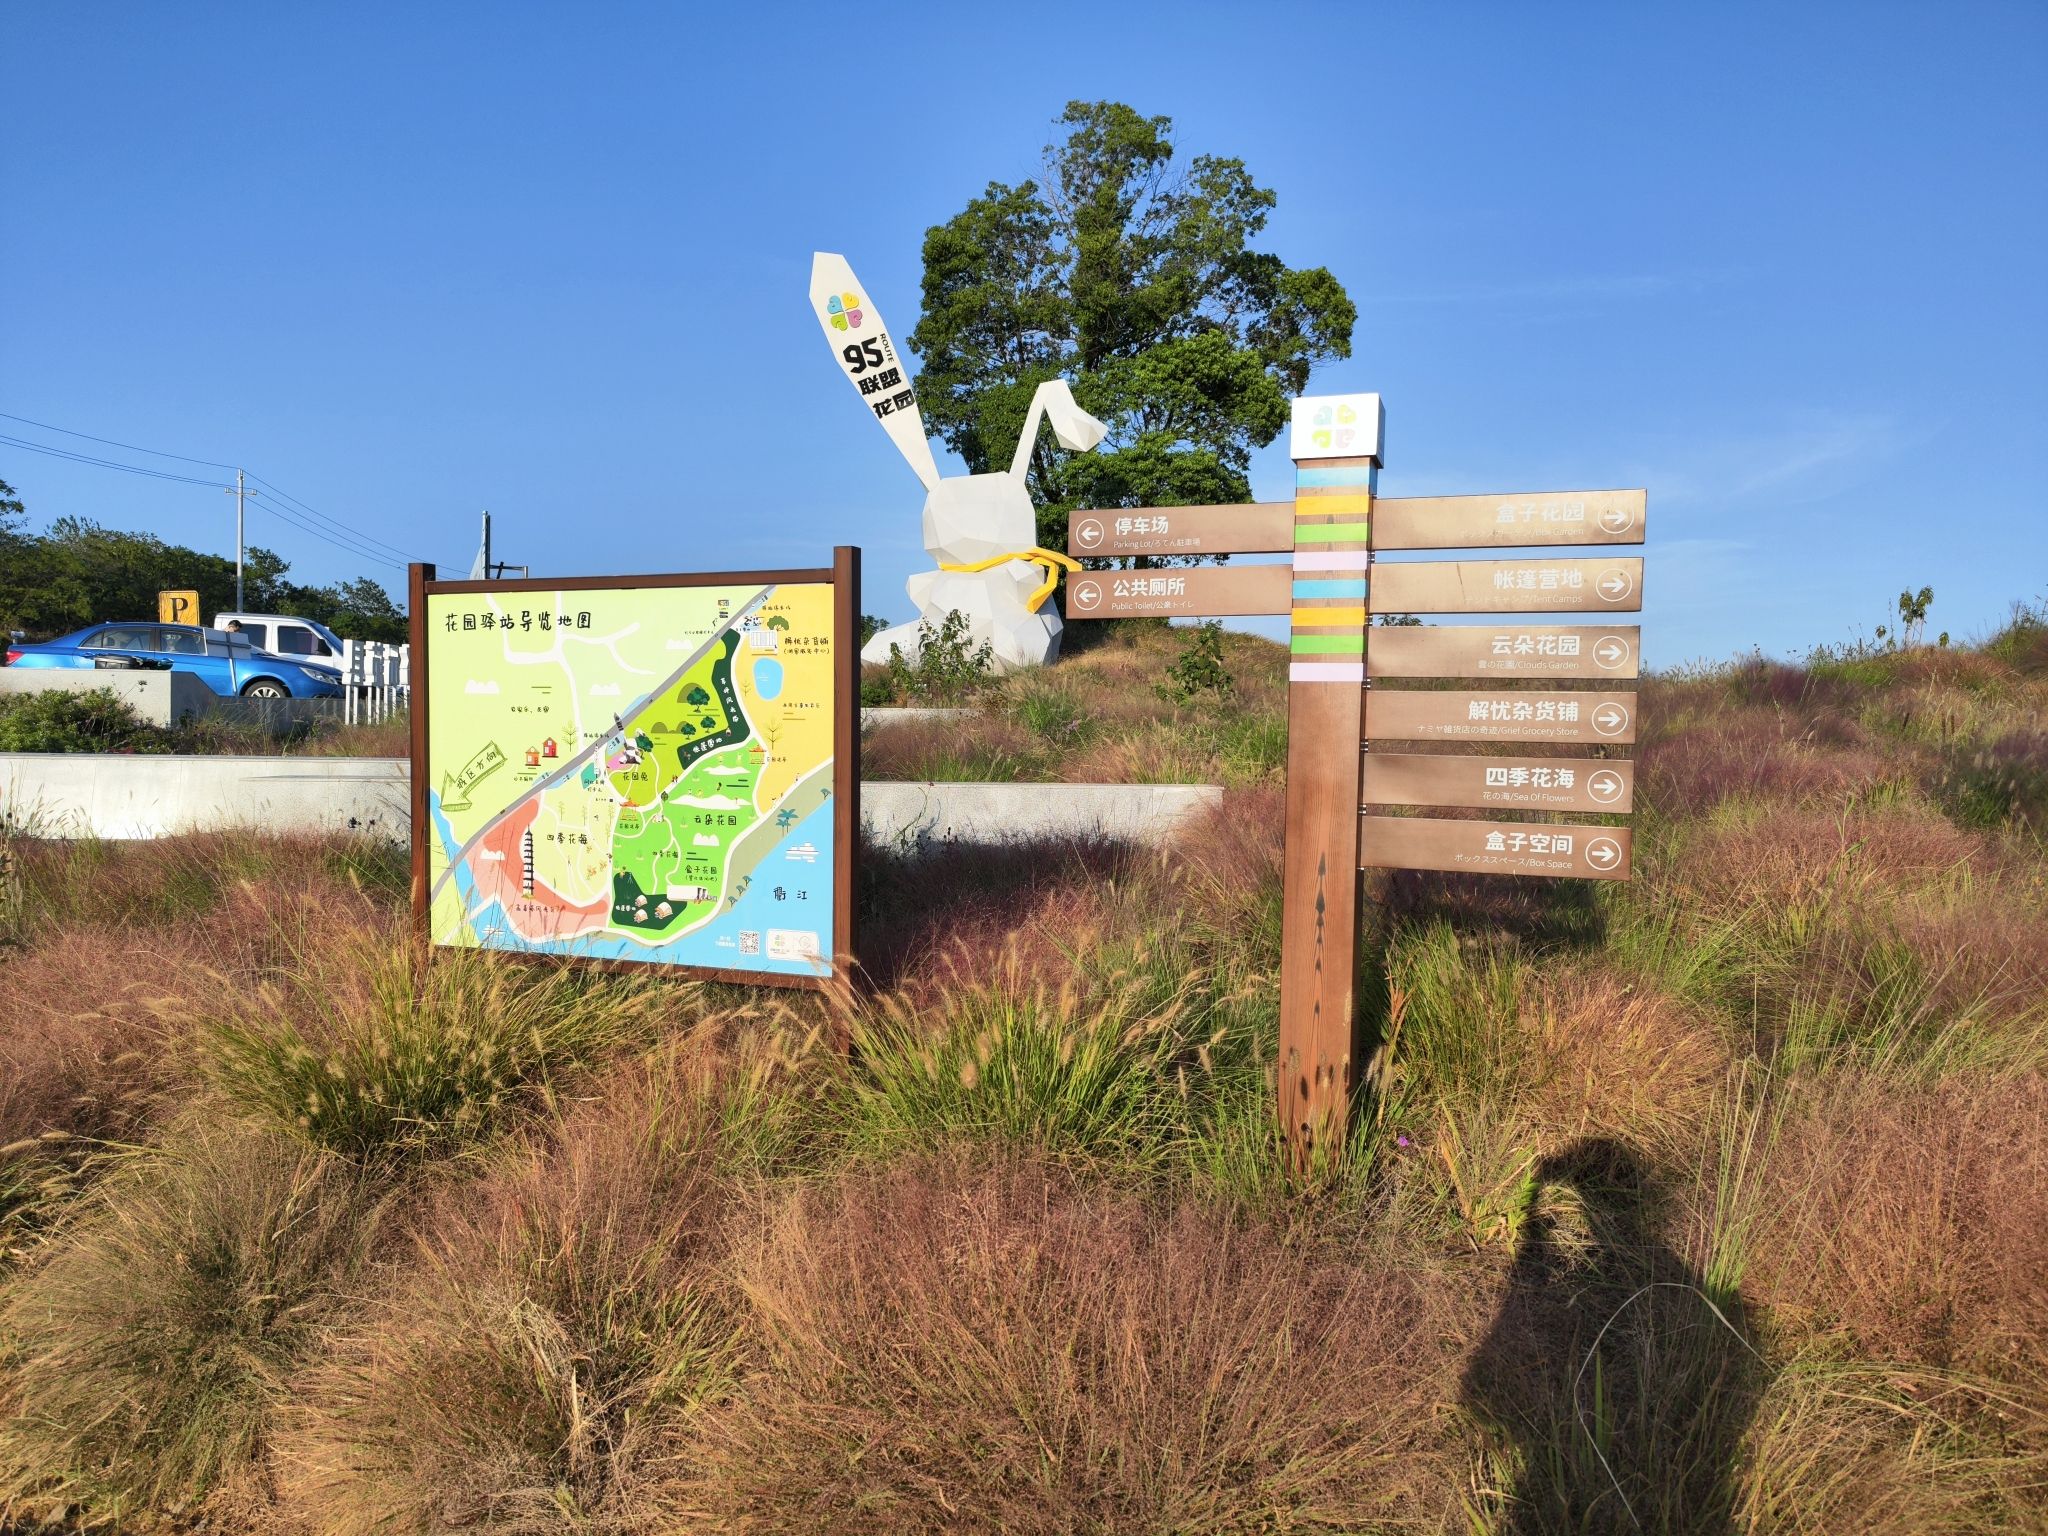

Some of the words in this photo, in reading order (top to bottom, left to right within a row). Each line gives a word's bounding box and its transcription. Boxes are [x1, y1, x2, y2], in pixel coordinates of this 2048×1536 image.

[843, 337, 884, 374] 95
[880, 333, 895, 362] ROUTE
[858, 367, 902, 396] 联盟
[873, 388, 916, 419] 花园
[1495, 501, 1585, 523] 盒子花园
[1114, 516, 1169, 536] 停车场
[1113, 540, 1139, 550] Parking
[1113, 577, 1186, 597] 公共厕所
[1493, 568, 1583, 590] 帐篷营地
[170, 597, 188, 622] P
[1111, 601, 1133, 611] Public
[445, 610, 591, 632] 花园驿站导览地图
[1491, 634, 1580, 656] 云朵花园
[1548, 661, 1579, 670] Garden
[1468, 700, 1579, 722] 解忧杂货铺
[1522, 726, 1555, 737] Grocery
[1556, 727, 1579, 736] Store
[457, 751, 497, 789] 城区方向
[1486, 767, 1575, 788] 四季花海
[1530, 792, 1540, 801] Of
[1542, 793, 1575, 803] Flowers
[694, 814, 737, 826] 云朵花园
[1485, 830, 1573, 855] 盒子空间
[1547, 859, 1573, 869] Space
[773, 886, 808, 901] 衢江
